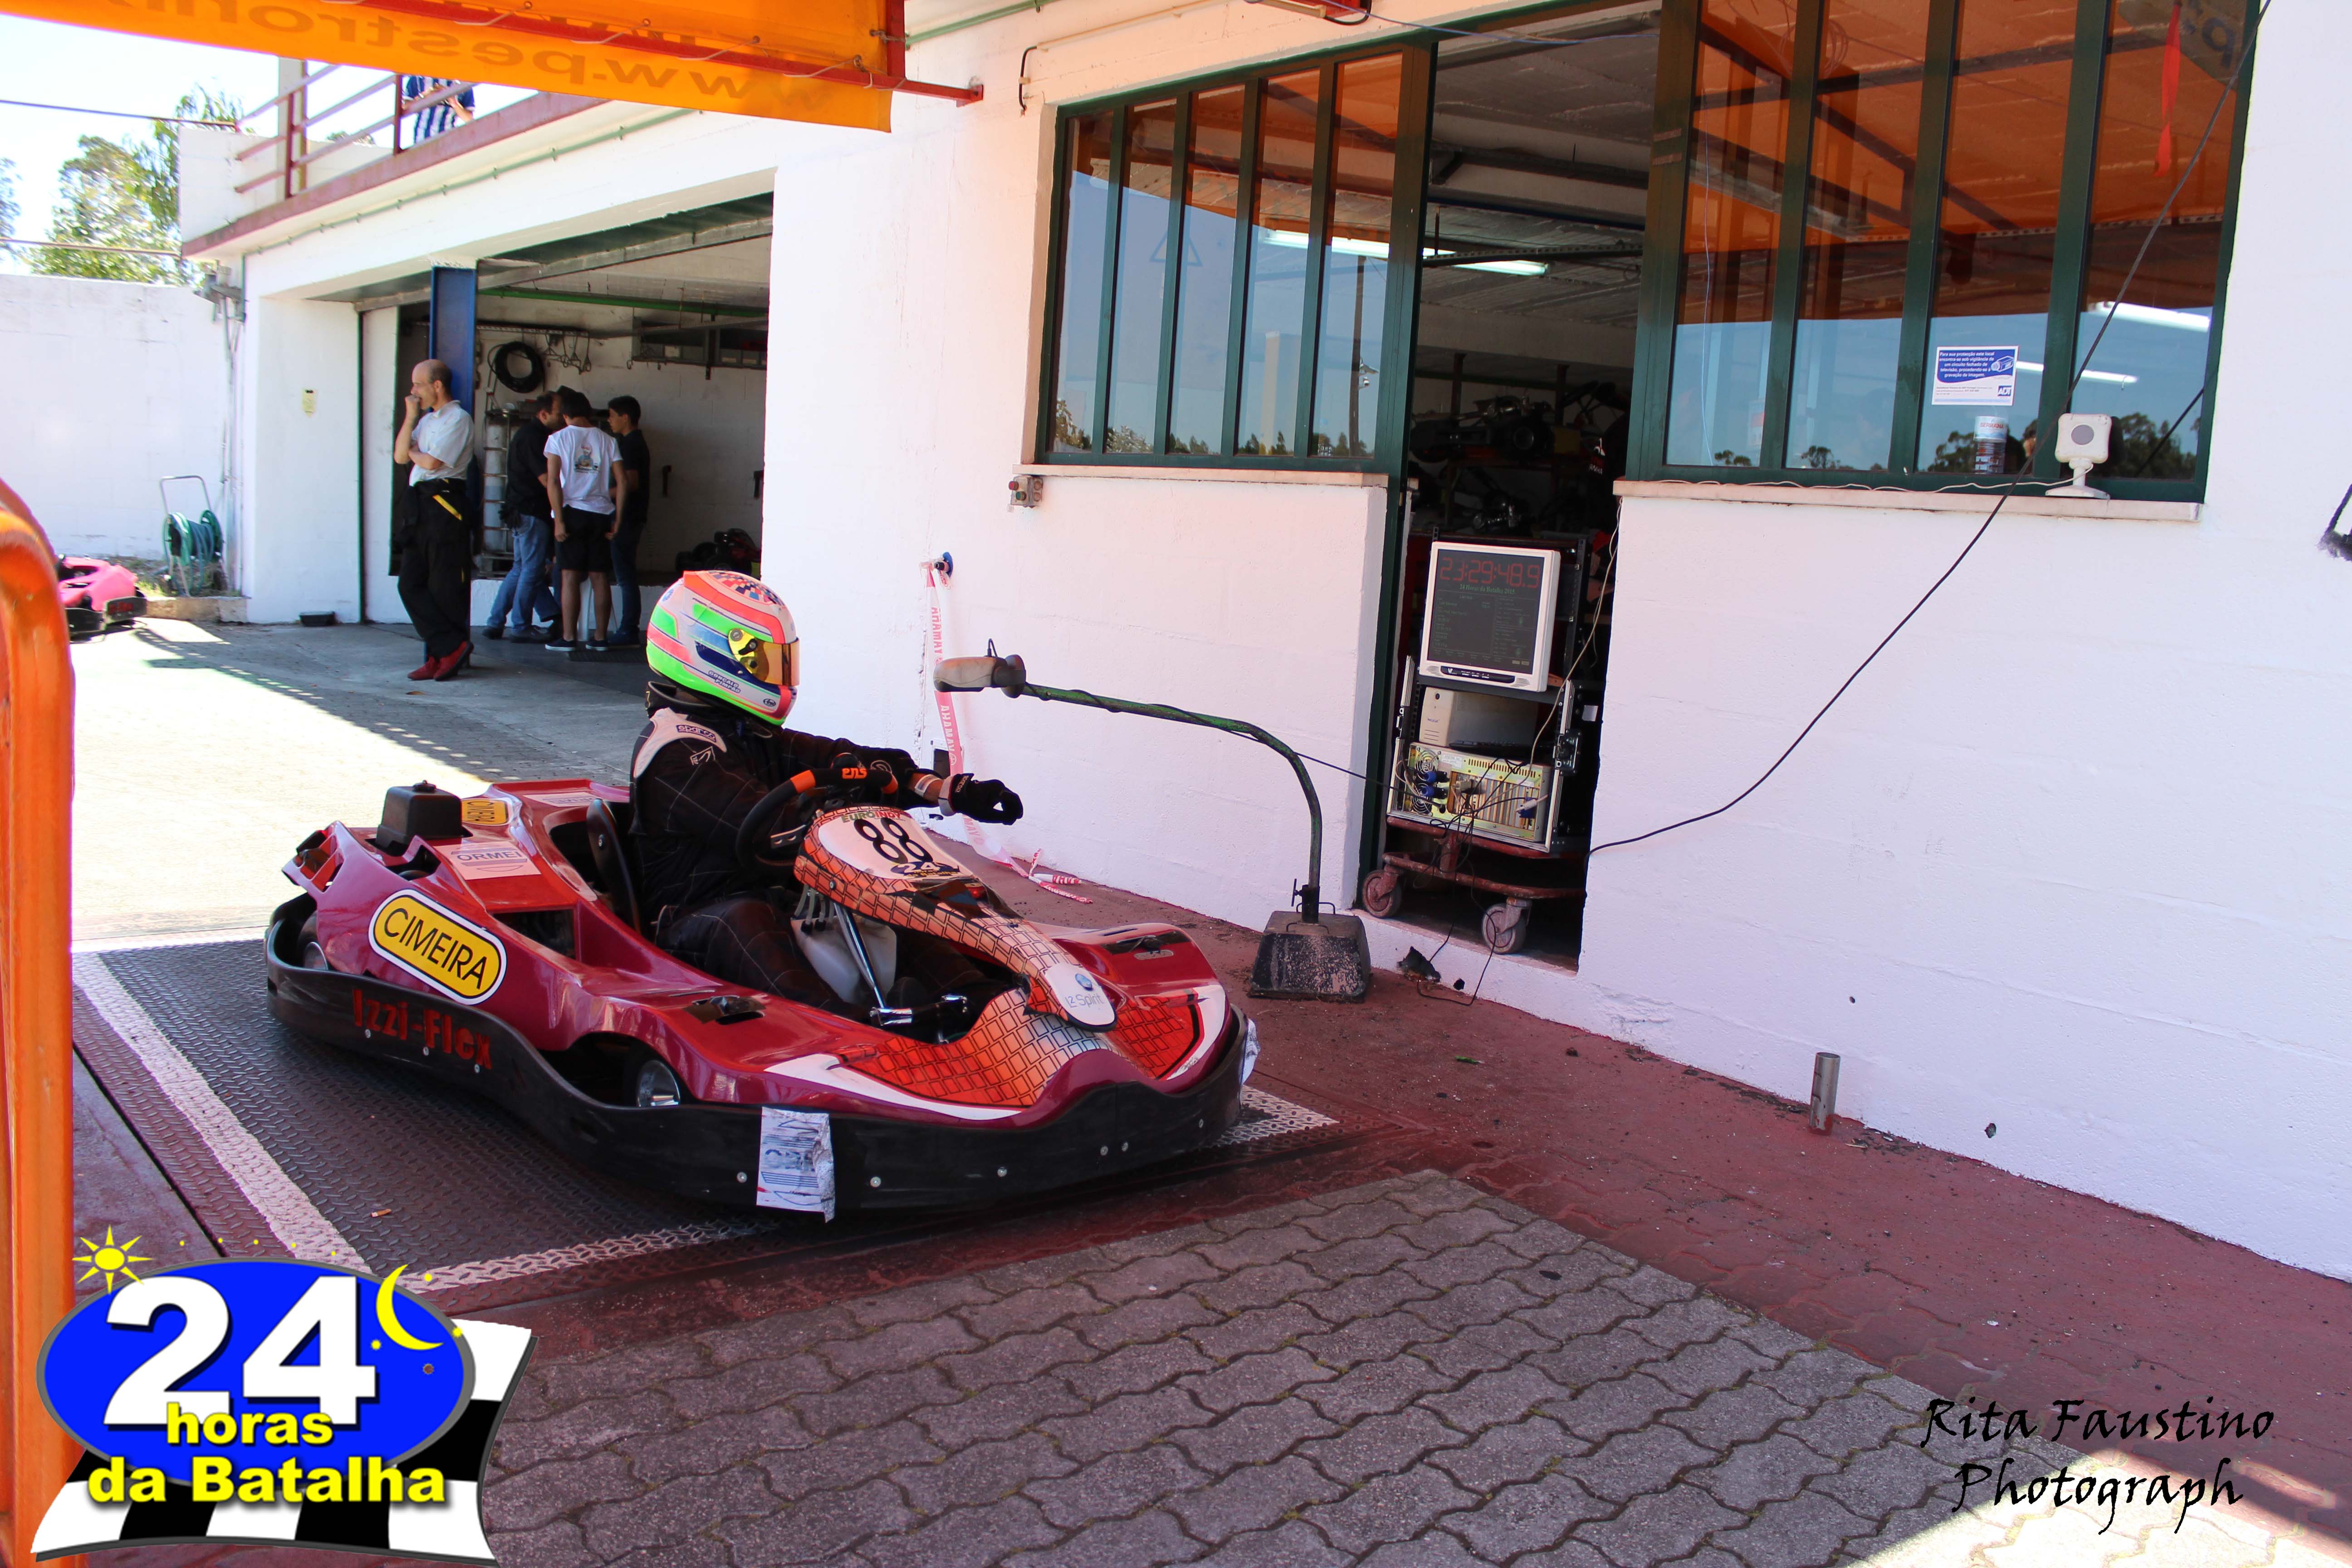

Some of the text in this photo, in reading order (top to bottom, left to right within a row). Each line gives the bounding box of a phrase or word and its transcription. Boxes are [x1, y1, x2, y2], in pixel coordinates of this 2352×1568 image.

[1997, 387, 2011, 395] ADT
[853, 817, 932, 864] 88
[898, 862, 940, 873] 24
[384, 908, 487, 990] CIMEIRA
[1076, 994, 1104, 1008] Spirit
[353, 989, 492, 1069] Izzi-Flex
